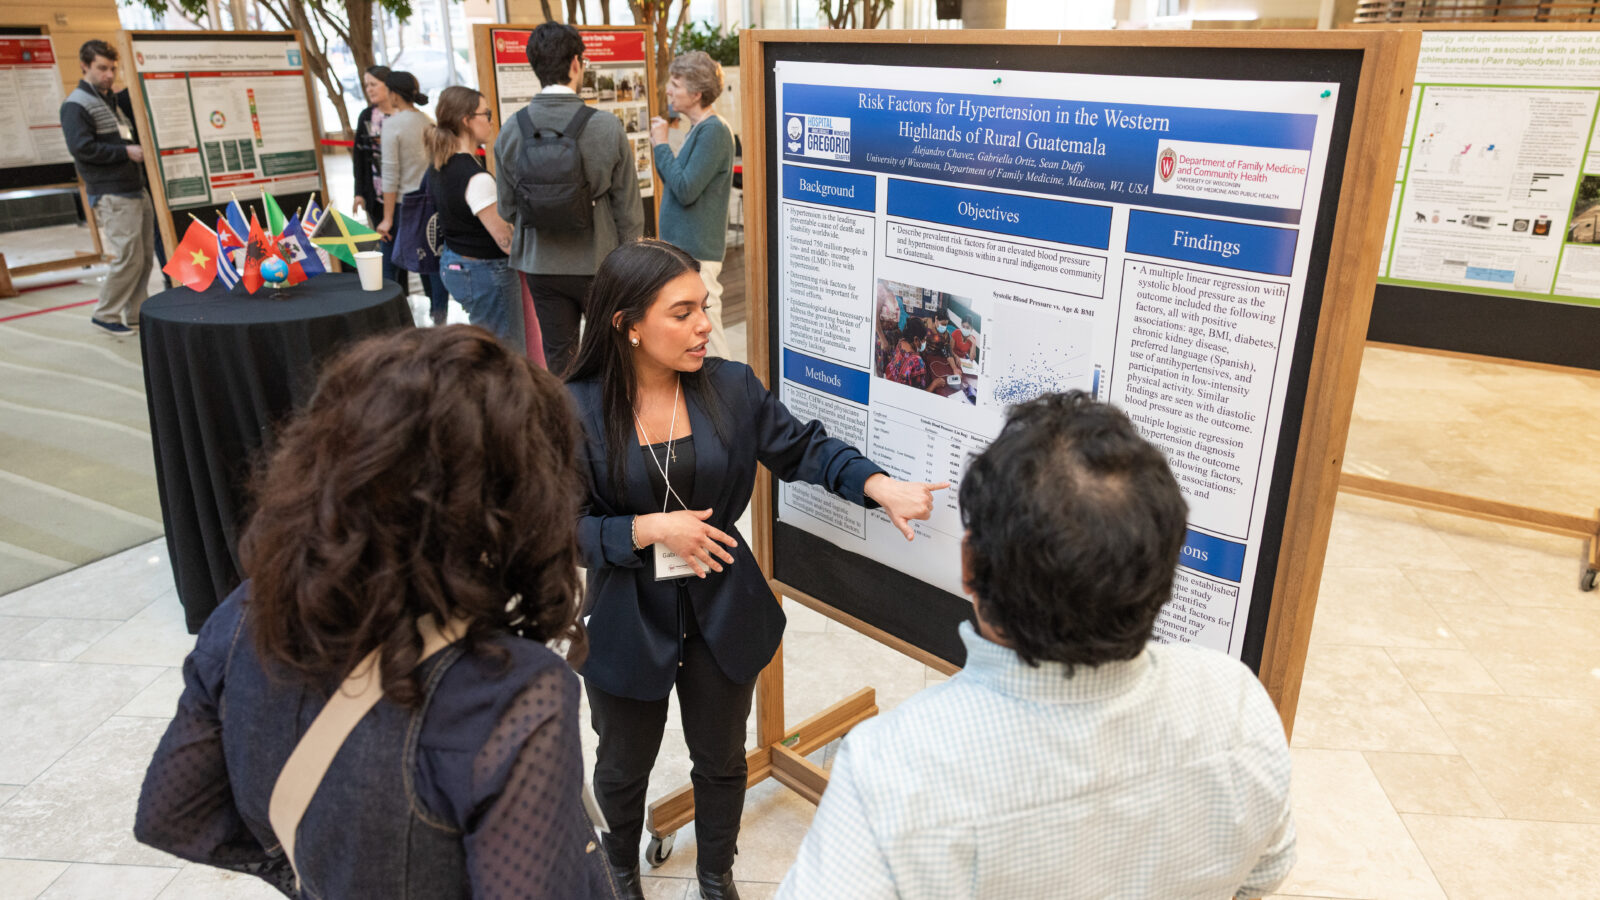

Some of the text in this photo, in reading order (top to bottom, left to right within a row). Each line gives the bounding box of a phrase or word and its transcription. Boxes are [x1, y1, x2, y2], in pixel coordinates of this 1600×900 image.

[808, 116, 832, 128] HOSPITAL
[859, 93, 1169, 131] Risk Factors for Hypertension in the Western
[808, 134, 850, 154] GREGORIO
[900, 121, 1106, 156] Highlands of Rural Guatemala
[912, 145, 1085, 174] Alejandro Chavez, Gabriella Ortiz, Sean Duffy
[1179, 155, 1306, 175] Department of Family Medicine
[867, 153, 1148, 195] University of Wisconsin, Department of Family Medicine, Madison, WI, USA
[1194, 168, 1238, 181] Community
[1240, 172, 1267, 182] Health
[800, 179, 855, 198] Background
[958, 201, 1020, 223] Objectives
[898, 226, 921, 237] Describe
[923, 232, 950, 242] prevalent
[951, 236, 962, 245] risk
[964, 238, 985, 249] factors
[987, 241, 996, 250] for
[1007, 245, 1036, 258] elevated
[1038, 250, 1058, 261] blood
[1059, 256, 1090, 267] pressure
[1173, 230, 1240, 258] Findings
[908, 238, 944, 252] hypertension
[946, 245, 974, 257] diagnosis
[976, 252, 996, 262] within
[1003, 257, 1018, 266] rural
[1020, 260, 1058, 272] indigenous
[1060, 268, 1102, 282] community
[1138, 280, 1169, 291] systolic
[1172, 283, 1196, 296] blood
[1198, 290, 1235, 302] pressure
[1250, 297, 1265, 308] the
[1140, 266, 1286, 297] A multiple linear regression with
[993, 291, 1011, 300] Systolic
[1013, 295, 1028, 304] Blood
[1029, 298, 1052, 308] Pressure
[1081, 308, 1094, 317] BMI
[1136, 302, 1237, 329] factors, all with positive
[1137, 292, 1276, 323] outcome included the following
[1133, 326, 1229, 354] chronic kidney disease,
[1134, 316, 1276, 349] associations: age, BMI, diabetes,
[1130, 351, 1252, 383] use of antihypertensives, and
[1131, 339, 1256, 372] preferred language (Spanish),
[806, 366, 842, 387] Methods
[1127, 373, 1229, 404] physical activity. Similar
[1128, 362, 1249, 397] participation in low-intensity
[1125, 394, 1147, 407] blood
[1149, 403, 1182, 416] pressure
[1196, 413, 1209, 423] the
[1211, 419, 1252, 434] outcome.
[1126, 383, 1256, 422] findings are seen with diastolic
[1131, 414, 1244, 448] multiple logistic regression
[1141, 426, 1192, 444] hypertension
[1194, 441, 1235, 458] diagnosis
[1169, 457, 1243, 486] following factors,
[1187, 451, 1200, 461] the
[1202, 457, 1240, 472] outcome
[1182, 474, 1236, 495] associations:
[1194, 490, 1209, 499] and
[1190, 579, 1236, 597] established
[1191, 589, 1212, 602] study
[1172, 603, 1231, 626] risk factors for
[1172, 614, 1187, 623] and
[1189, 619, 1205, 630] may
[1180, 634, 1191, 643] for
